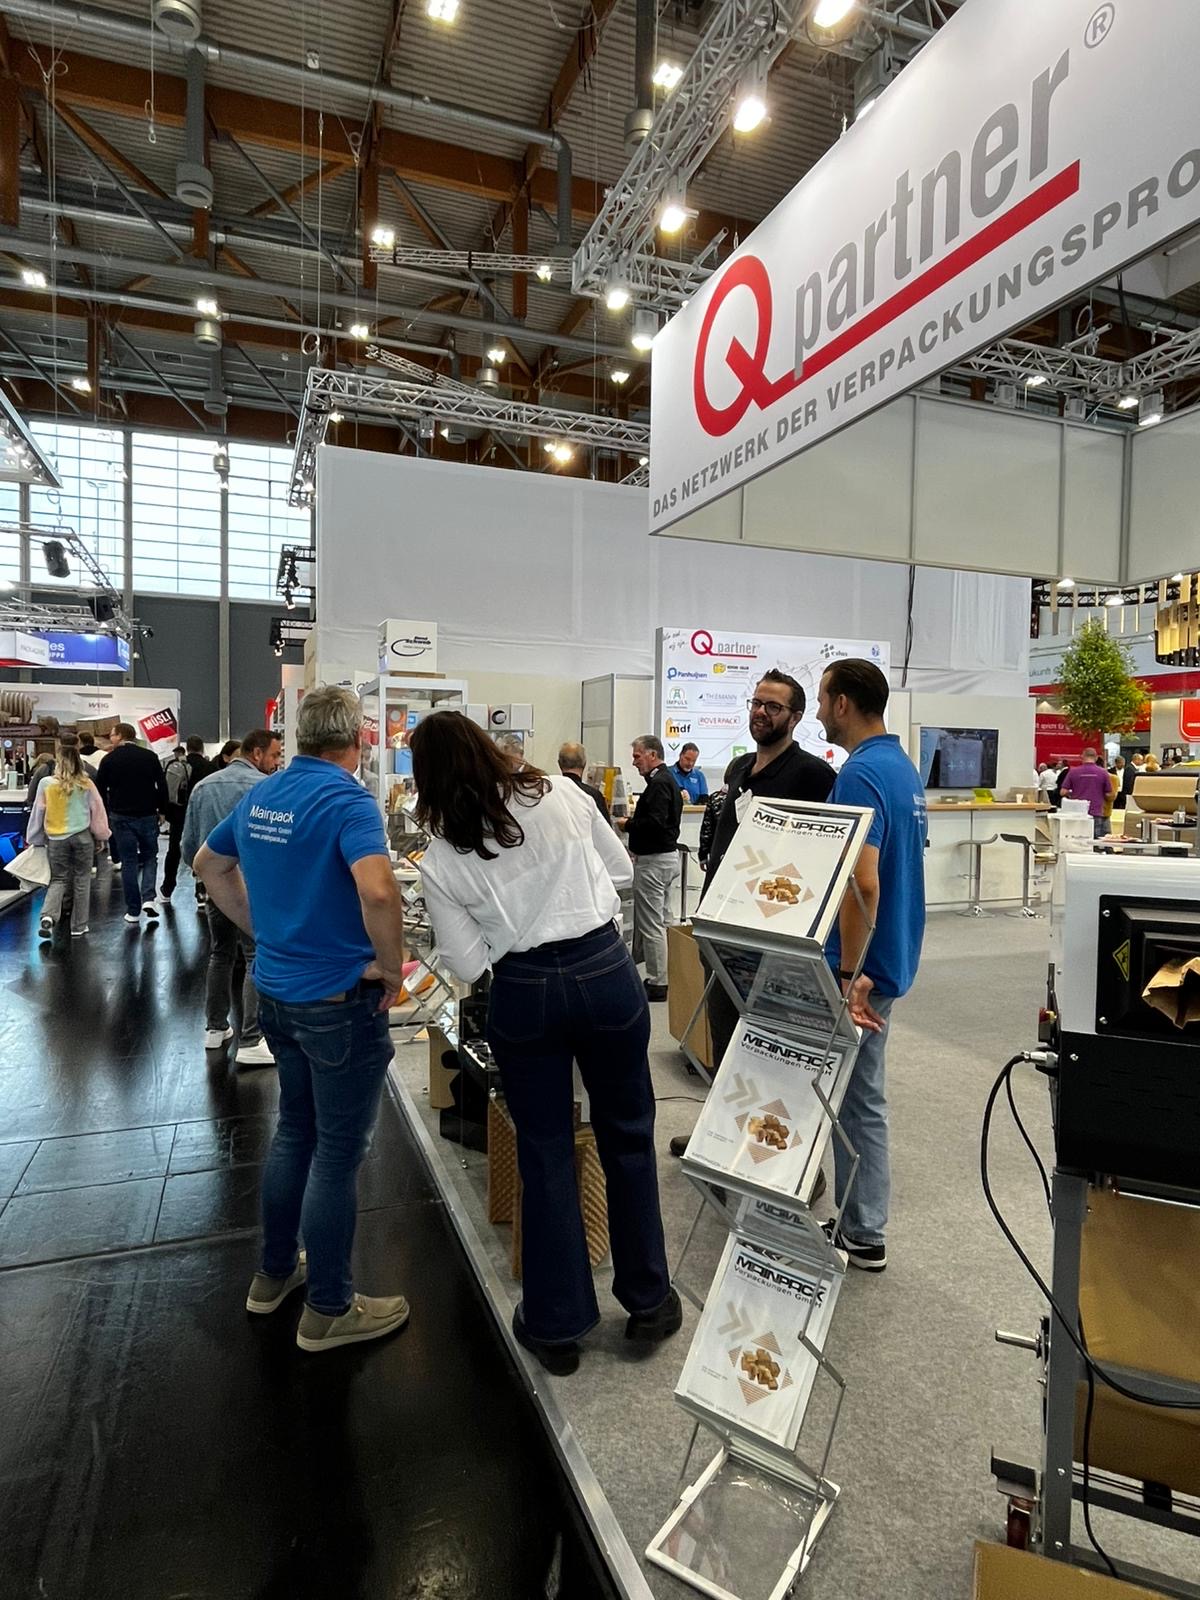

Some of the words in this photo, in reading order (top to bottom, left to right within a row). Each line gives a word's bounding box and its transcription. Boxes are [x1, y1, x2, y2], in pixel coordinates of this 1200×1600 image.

[794, 49, 1070, 381] partner
[653, 487, 677, 518] DAS
[681, 428, 769, 502] NETZWERK
[776, 397, 818, 443] DER
[827, 149, 1200, 412] VERPACKUNGSPRO
[717, 641, 757, 655] partner
[669, 724, 691, 733] mdf
[249, 804, 295, 824] Mainpack
[754, 811, 848, 834] MAINPACK
[743, 1033, 836, 1070] MAINPACK
[736, 1256, 826, 1302] MAINPACK
